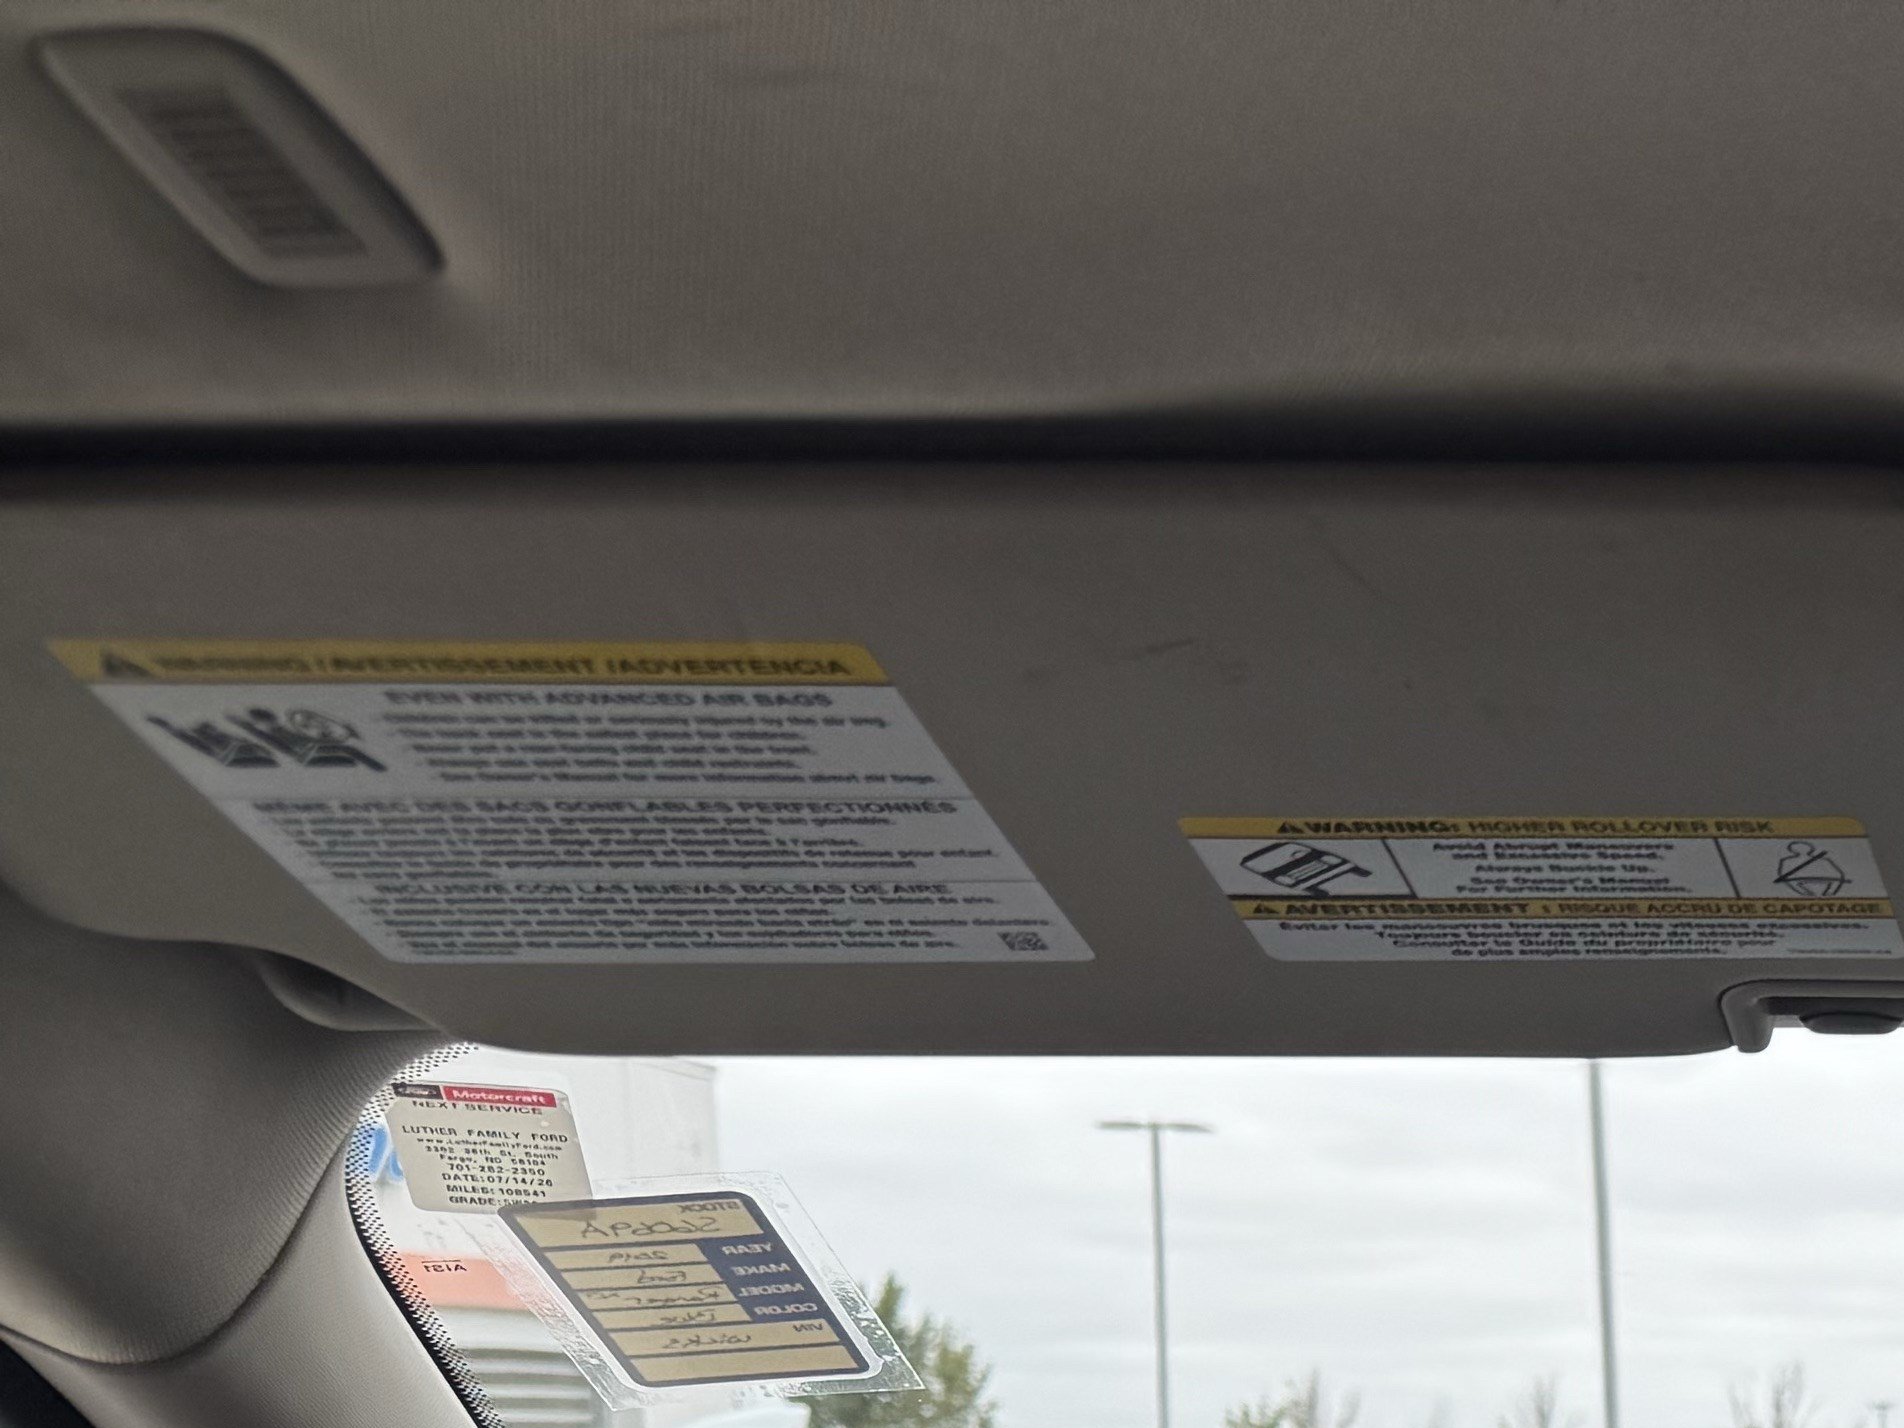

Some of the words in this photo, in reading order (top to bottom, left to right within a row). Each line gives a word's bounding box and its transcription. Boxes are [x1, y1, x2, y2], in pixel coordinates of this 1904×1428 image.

[702, 692, 744, 706] AIR
[751, 692, 832, 707] BAGS
[1570, 821, 1711, 833] ROLLOVER
[1716, 820, 1774, 833] RISK
[1730, 903, 1758, 915] DE
[1763, 902, 1884, 915] CAPOTAGE
[451, 1089, 546, 1105] Motorcraft
[412, 1100, 458, 1110] NEXT
[464, 1103, 543, 1116] SERVICE
[402, 1124, 458, 1137] LUTHER
[467, 1128, 520, 1139] FAMILY
[530, 1133, 569, 1143] FORD
